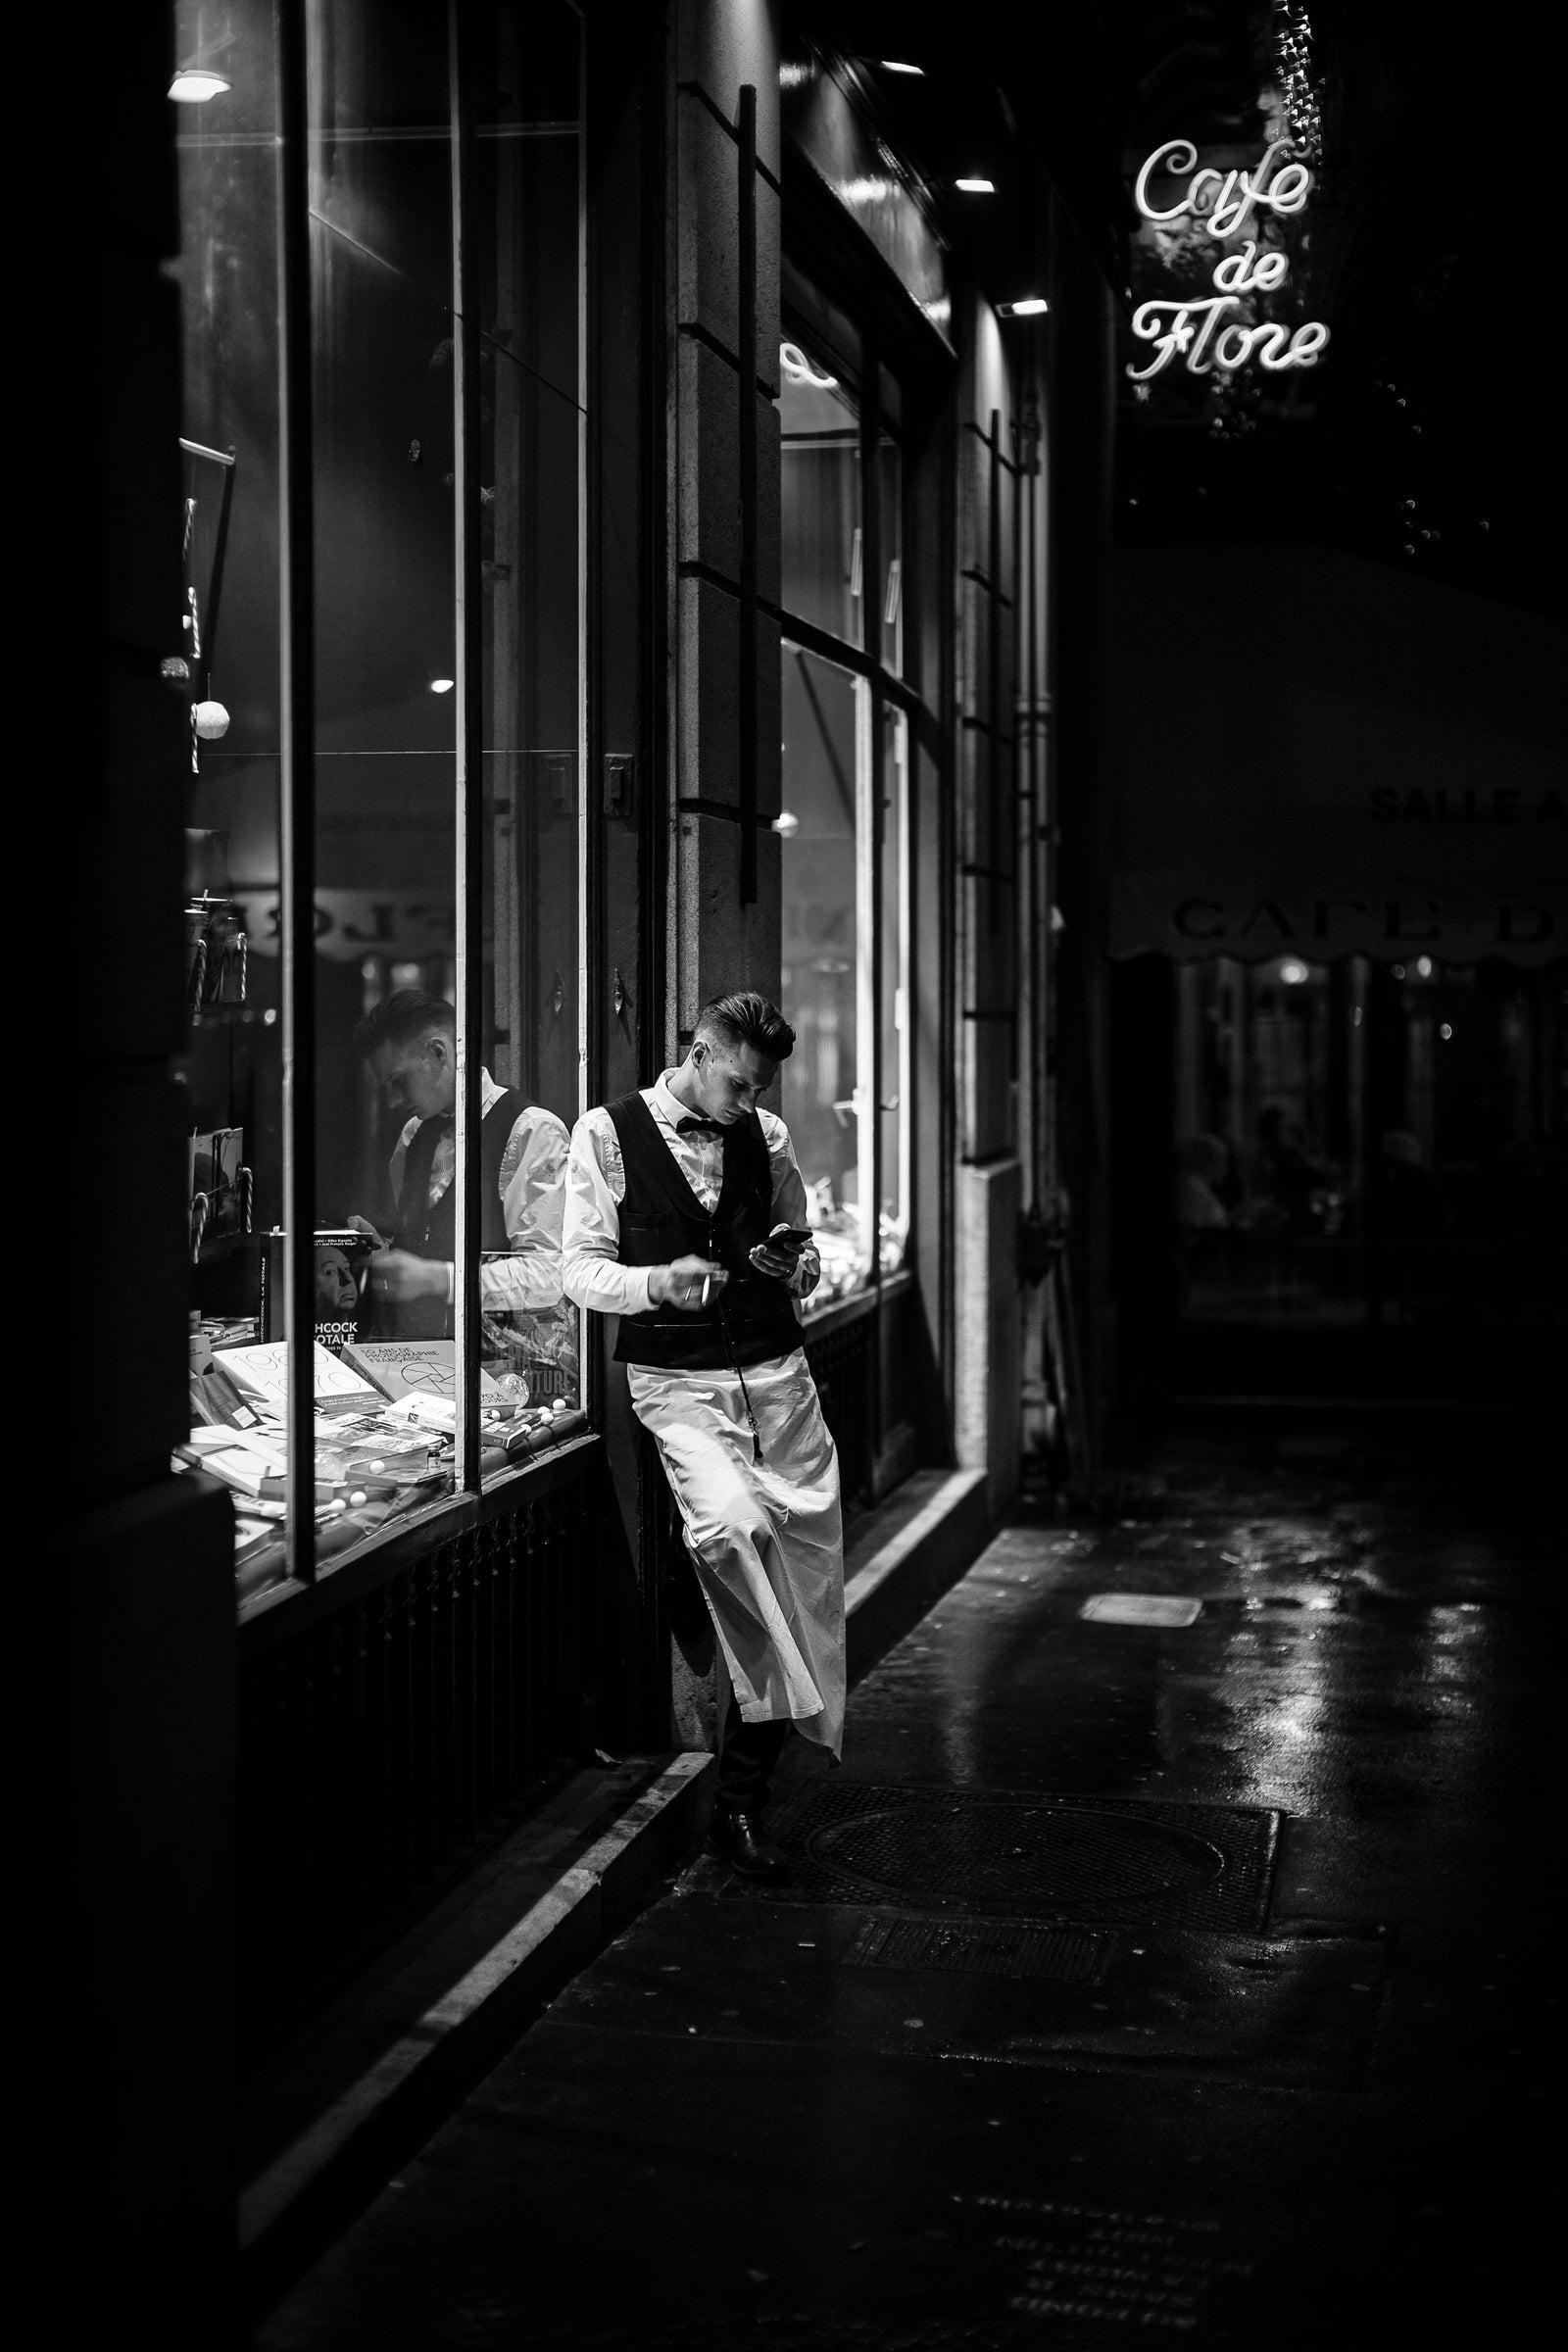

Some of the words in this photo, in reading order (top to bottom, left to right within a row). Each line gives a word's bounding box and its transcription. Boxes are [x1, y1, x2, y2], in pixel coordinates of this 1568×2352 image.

[1212, 240, 1289, 292] de
[1125, 296, 1331, 380] Flore
[1370, 788, 1521, 825] SALLE
[1536, 788, 1568, 825] A
[1495, 902, 1556, 944] D
[314, 1322, 358, 1334] HCOCK
[314, 1334, 355, 1345] OTALE
[365, 1350, 439, 1359] PHOTOGRAPHIE
